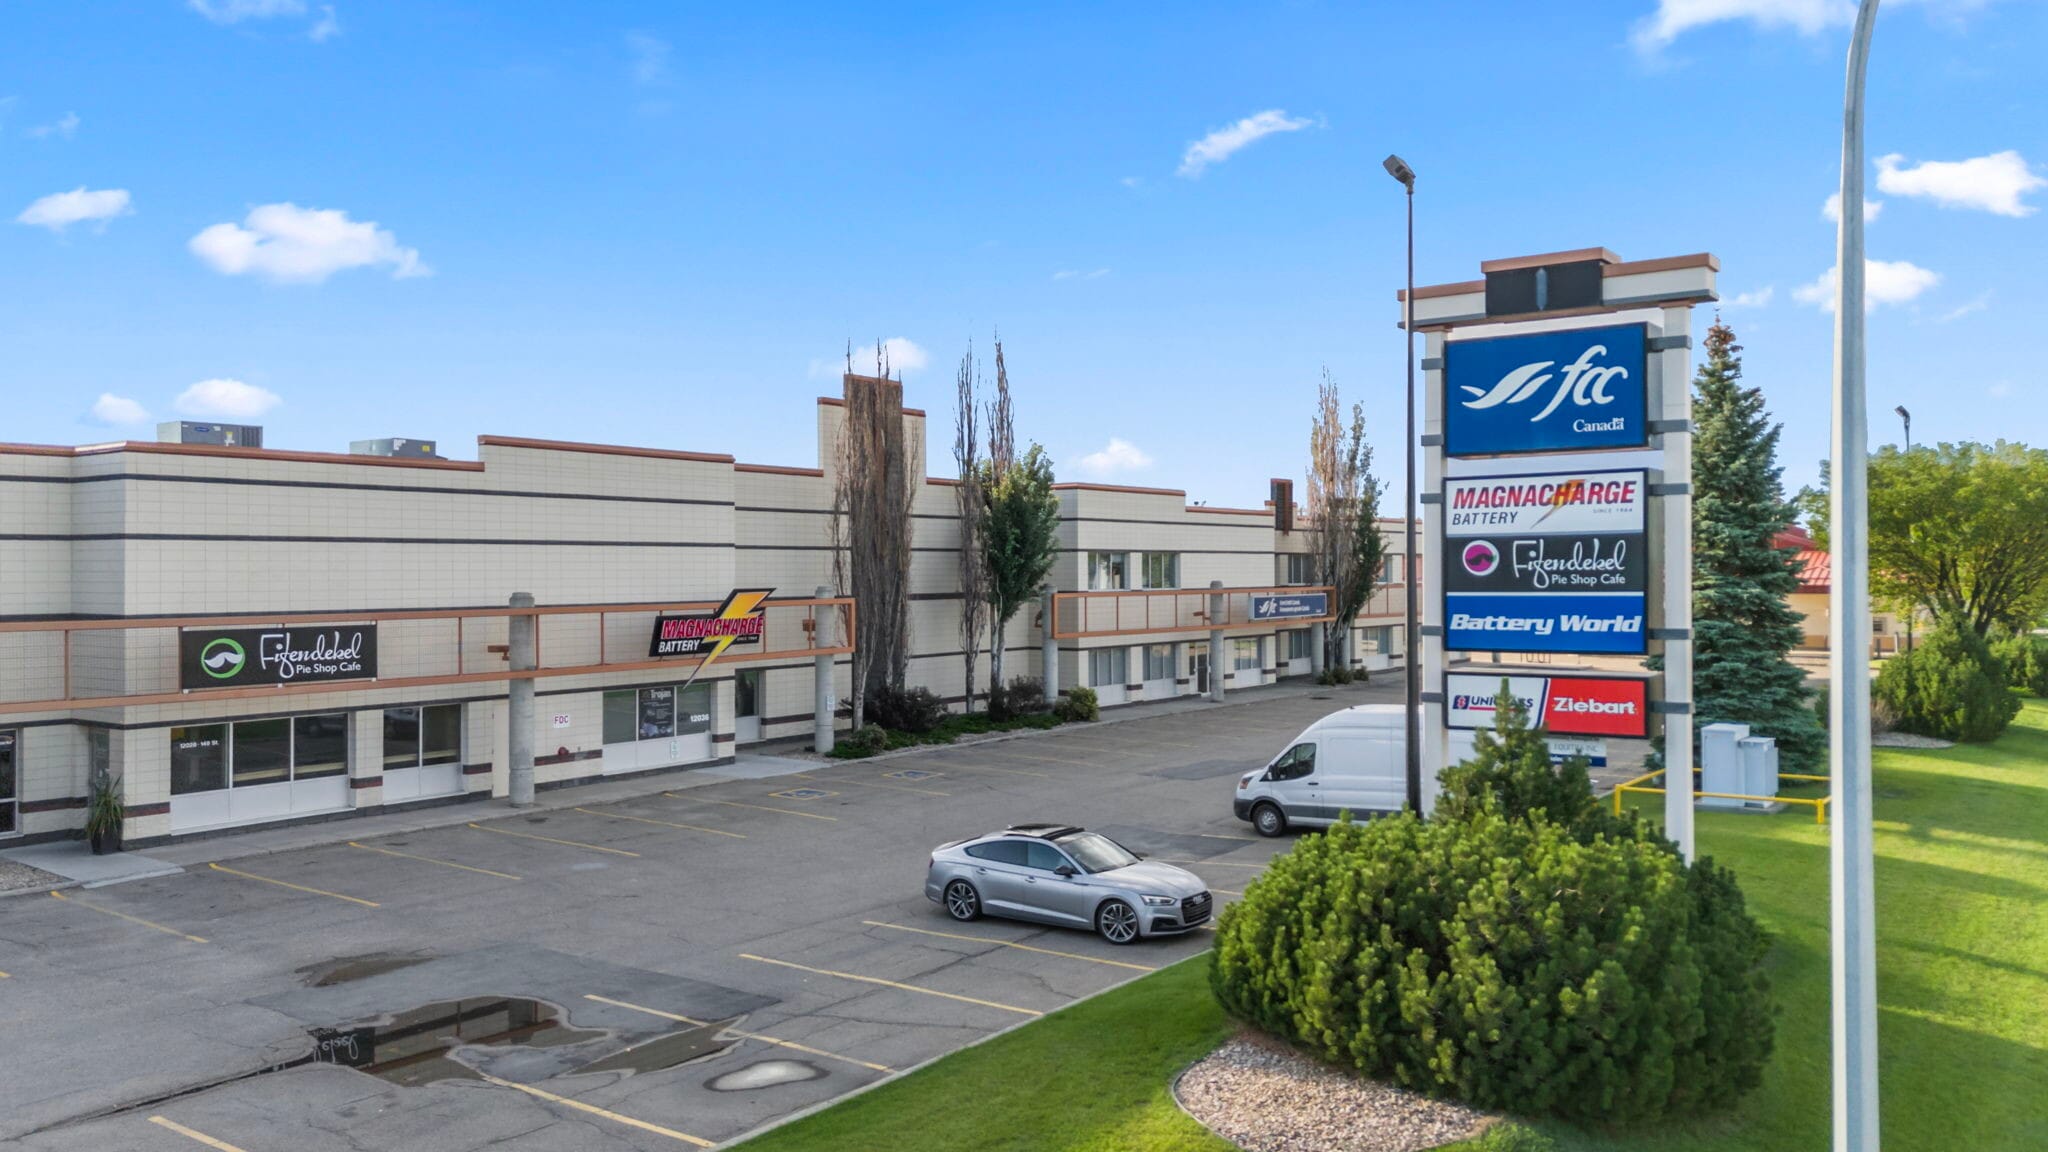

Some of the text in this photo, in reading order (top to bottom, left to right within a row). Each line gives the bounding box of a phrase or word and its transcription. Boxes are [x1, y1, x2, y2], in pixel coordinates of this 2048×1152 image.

[1531, 344, 1629, 422] fcc
[1573, 418, 1625, 433] Canada
[1452, 480, 1638, 510] MAGNACHARGE
[1452, 511, 1519, 526] BATTERY
[1551, 573, 1626, 587] Pie Shop Cafe
[661, 616, 766, 640] MAGNACHARGE
[1449, 614, 1643, 636] Battery World
[658, 639, 700, 653] BATTERY
[296, 661, 362, 676] Pie Shop Cafe
[650, 689, 672, 701] Trojan
[1552, 697, 1636, 715] Ziebart
